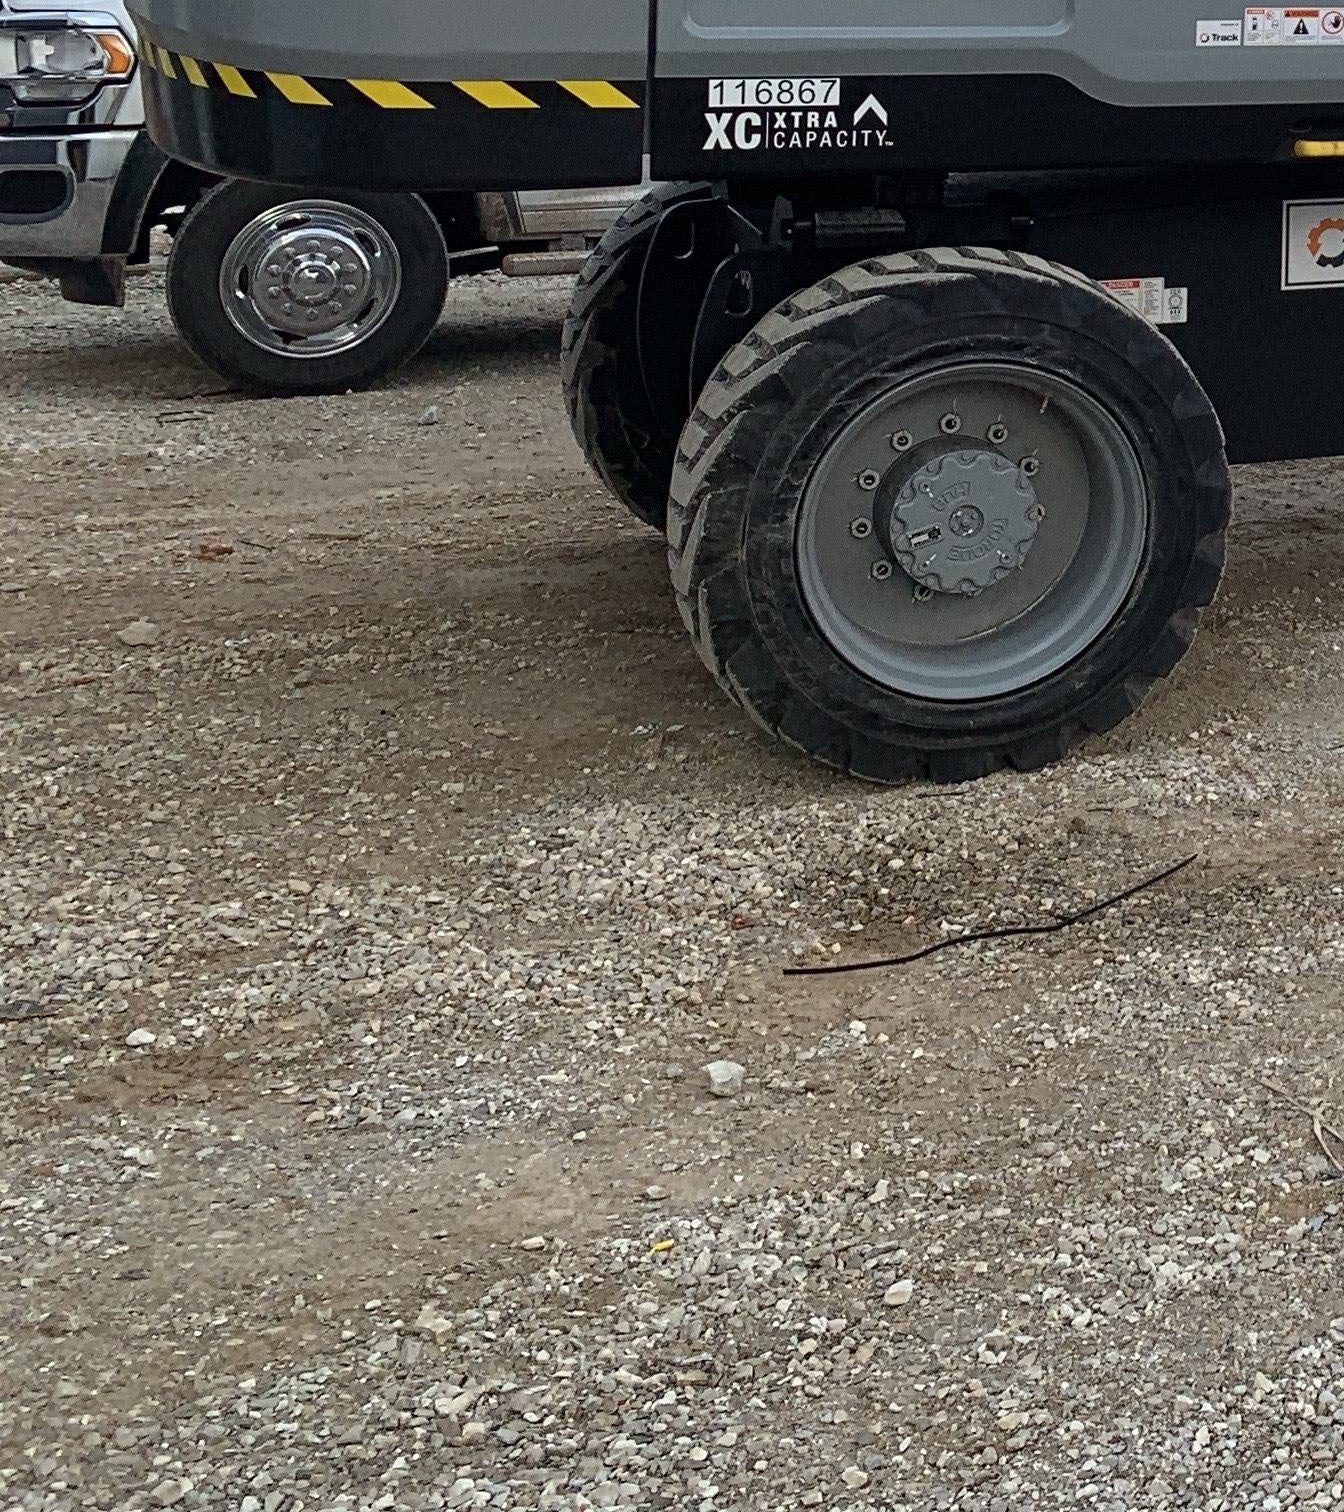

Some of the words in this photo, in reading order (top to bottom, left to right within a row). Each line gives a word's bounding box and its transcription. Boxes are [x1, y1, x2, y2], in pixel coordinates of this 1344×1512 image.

[1212, 33, 1239, 42] Track
[713, 80, 838, 105] 116867
[773, 111, 838, 129] XTRA
[702, 111, 762, 150] XC
[773, 130, 887, 149] CAPACITY
